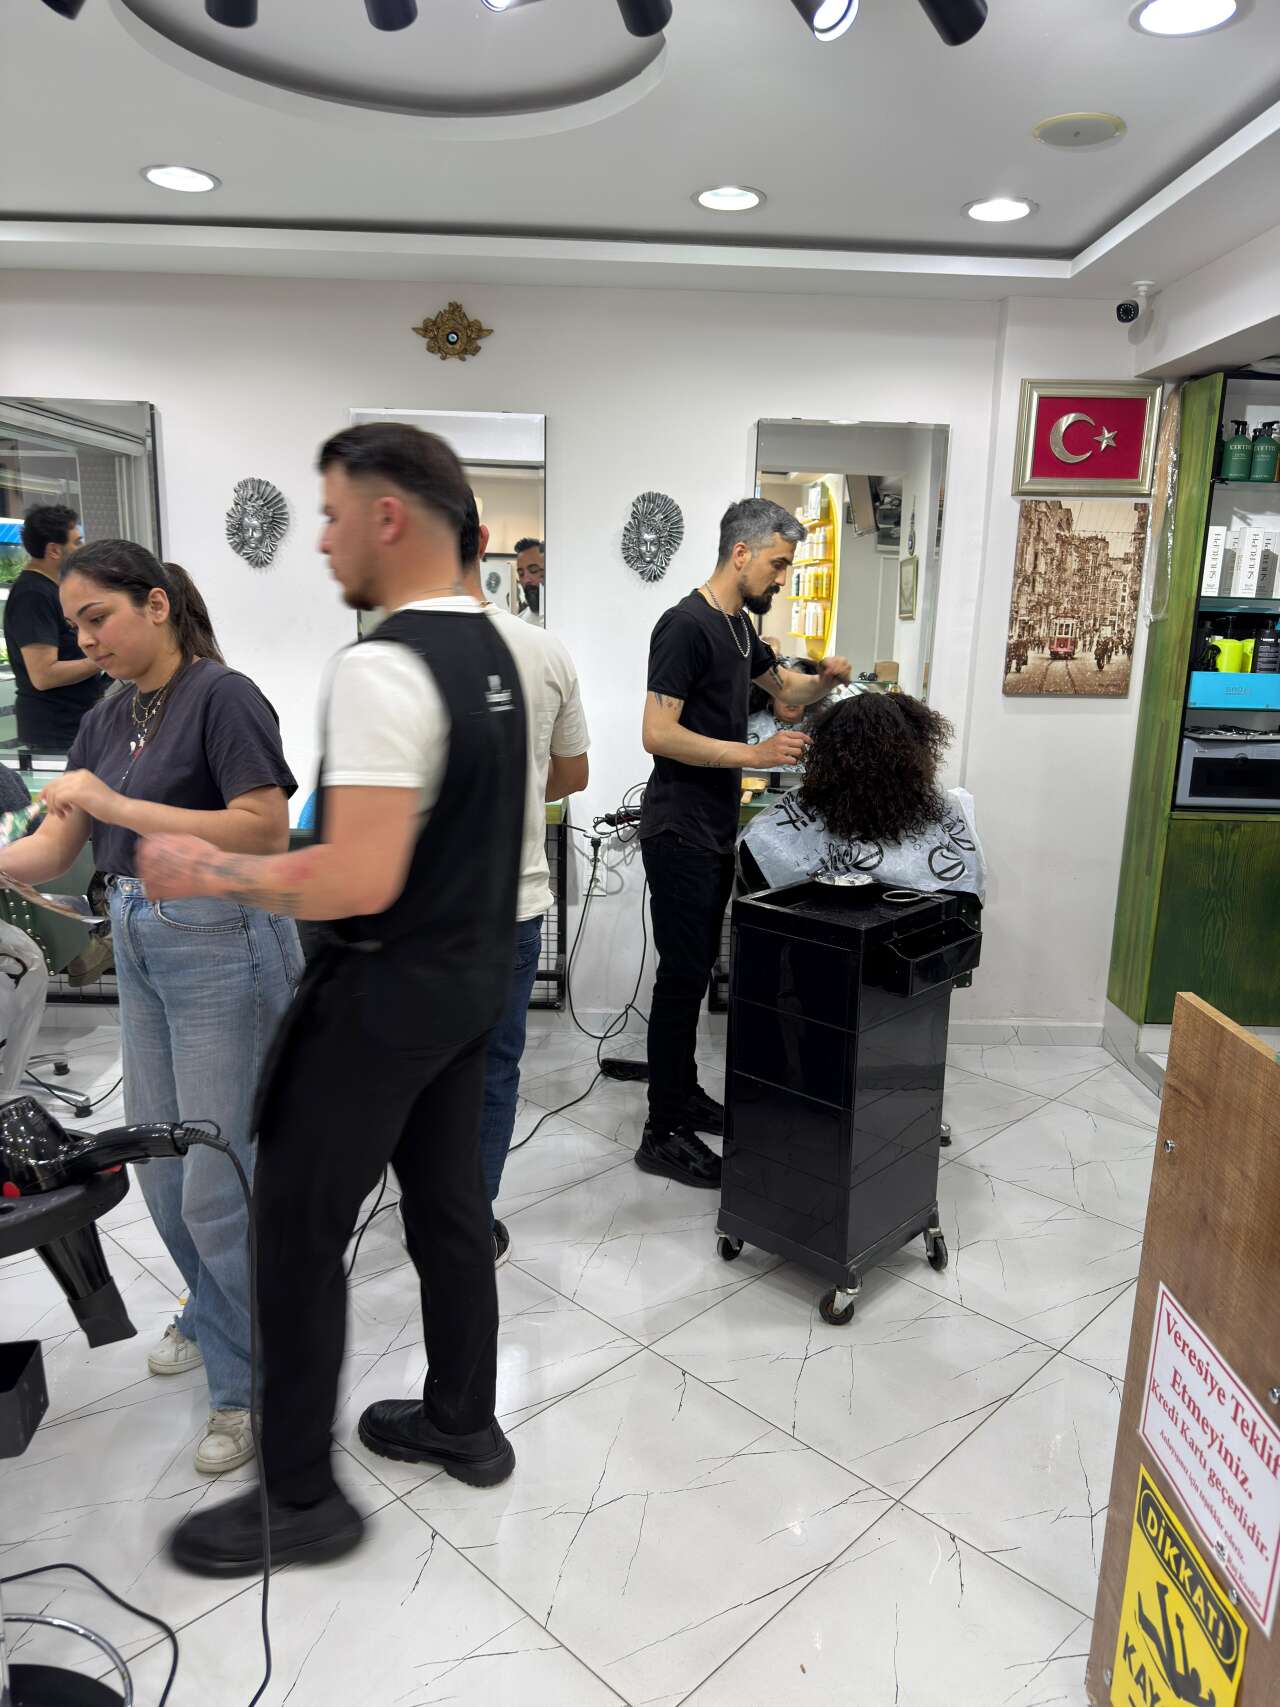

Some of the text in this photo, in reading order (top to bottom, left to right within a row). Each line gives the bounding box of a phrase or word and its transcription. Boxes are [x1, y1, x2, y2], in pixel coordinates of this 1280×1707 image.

[1151, 1377, 1269, 1562] Kredi Kartı geçerlidir.
[1166, 1309, 1280, 1480] Veresiye Teklif
[1171, 1366, 1253, 1499] Etmeyiniz.
[1146, 1506, 1225, 1649] DİKKAT!
